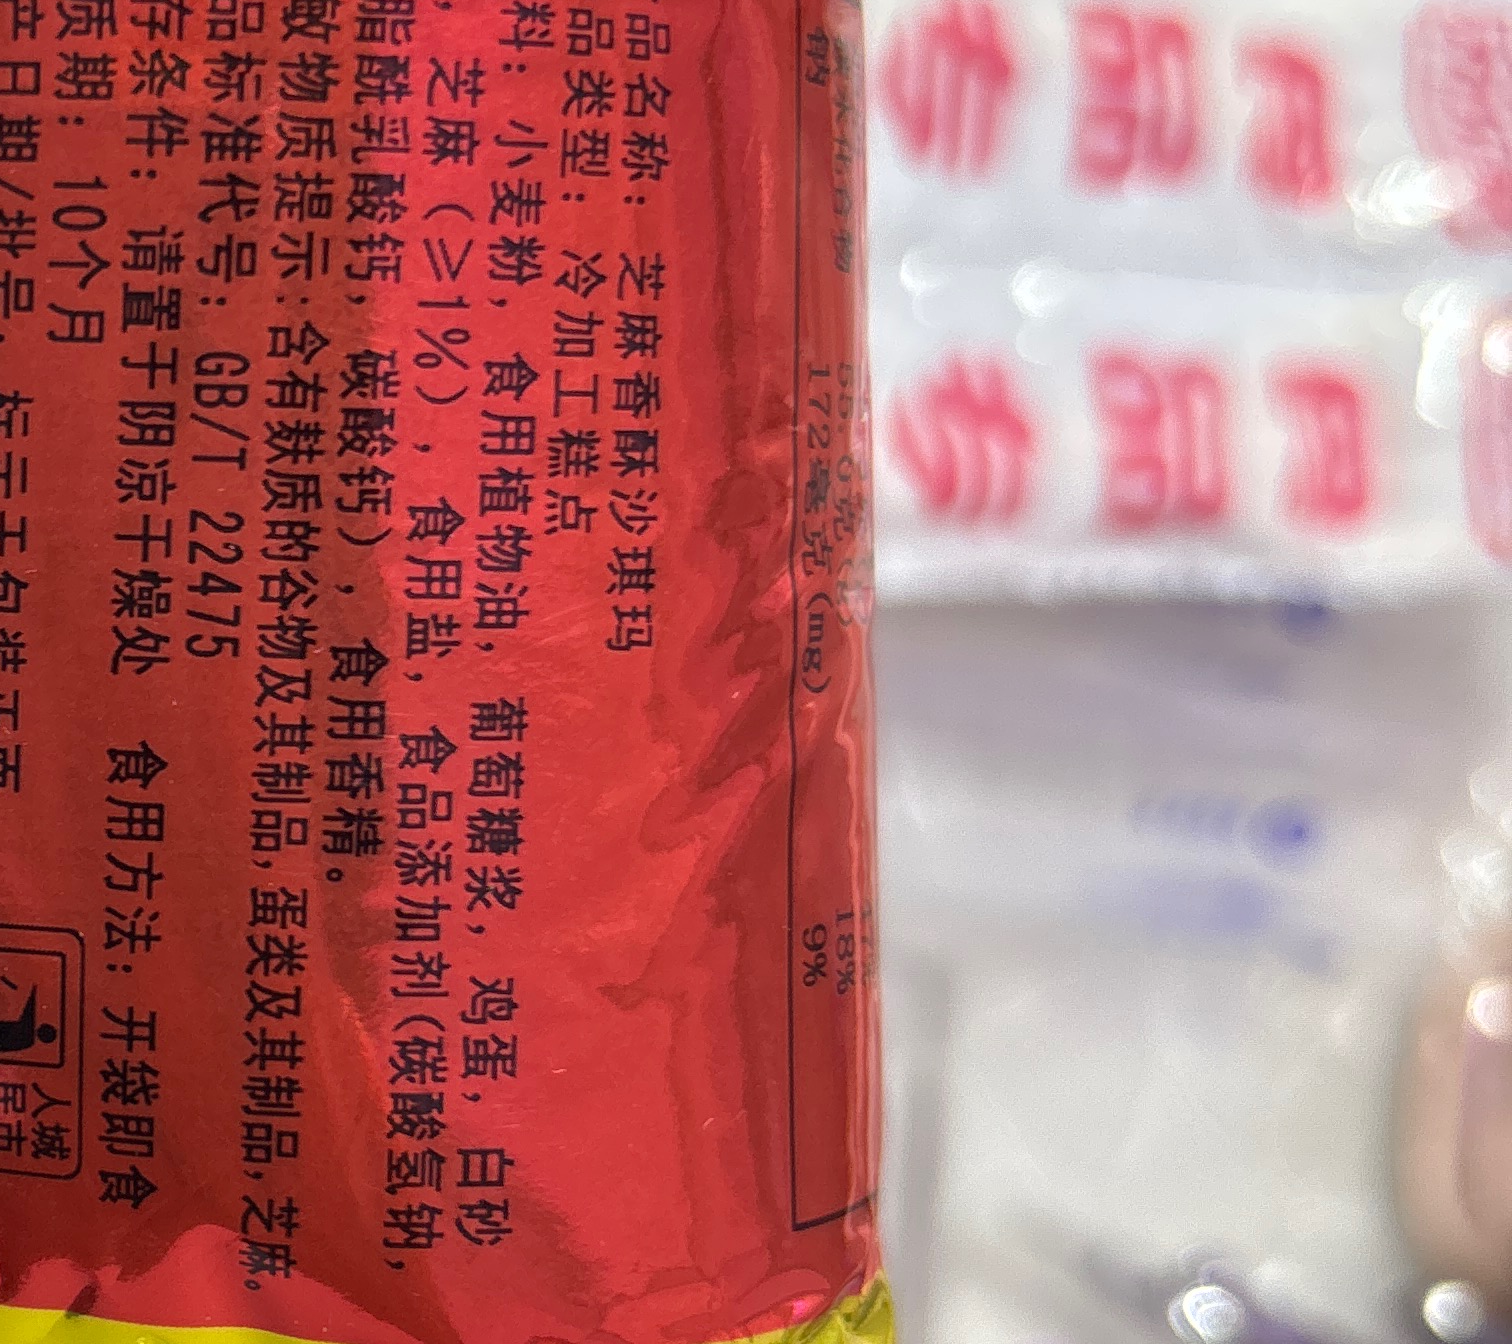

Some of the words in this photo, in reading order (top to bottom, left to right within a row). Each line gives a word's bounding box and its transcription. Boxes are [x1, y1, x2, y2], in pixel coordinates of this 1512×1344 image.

[802, 29, 831, 87] 钠
[184, 509, 246, 658] 22475
[801, 922, 829, 988] 9%
